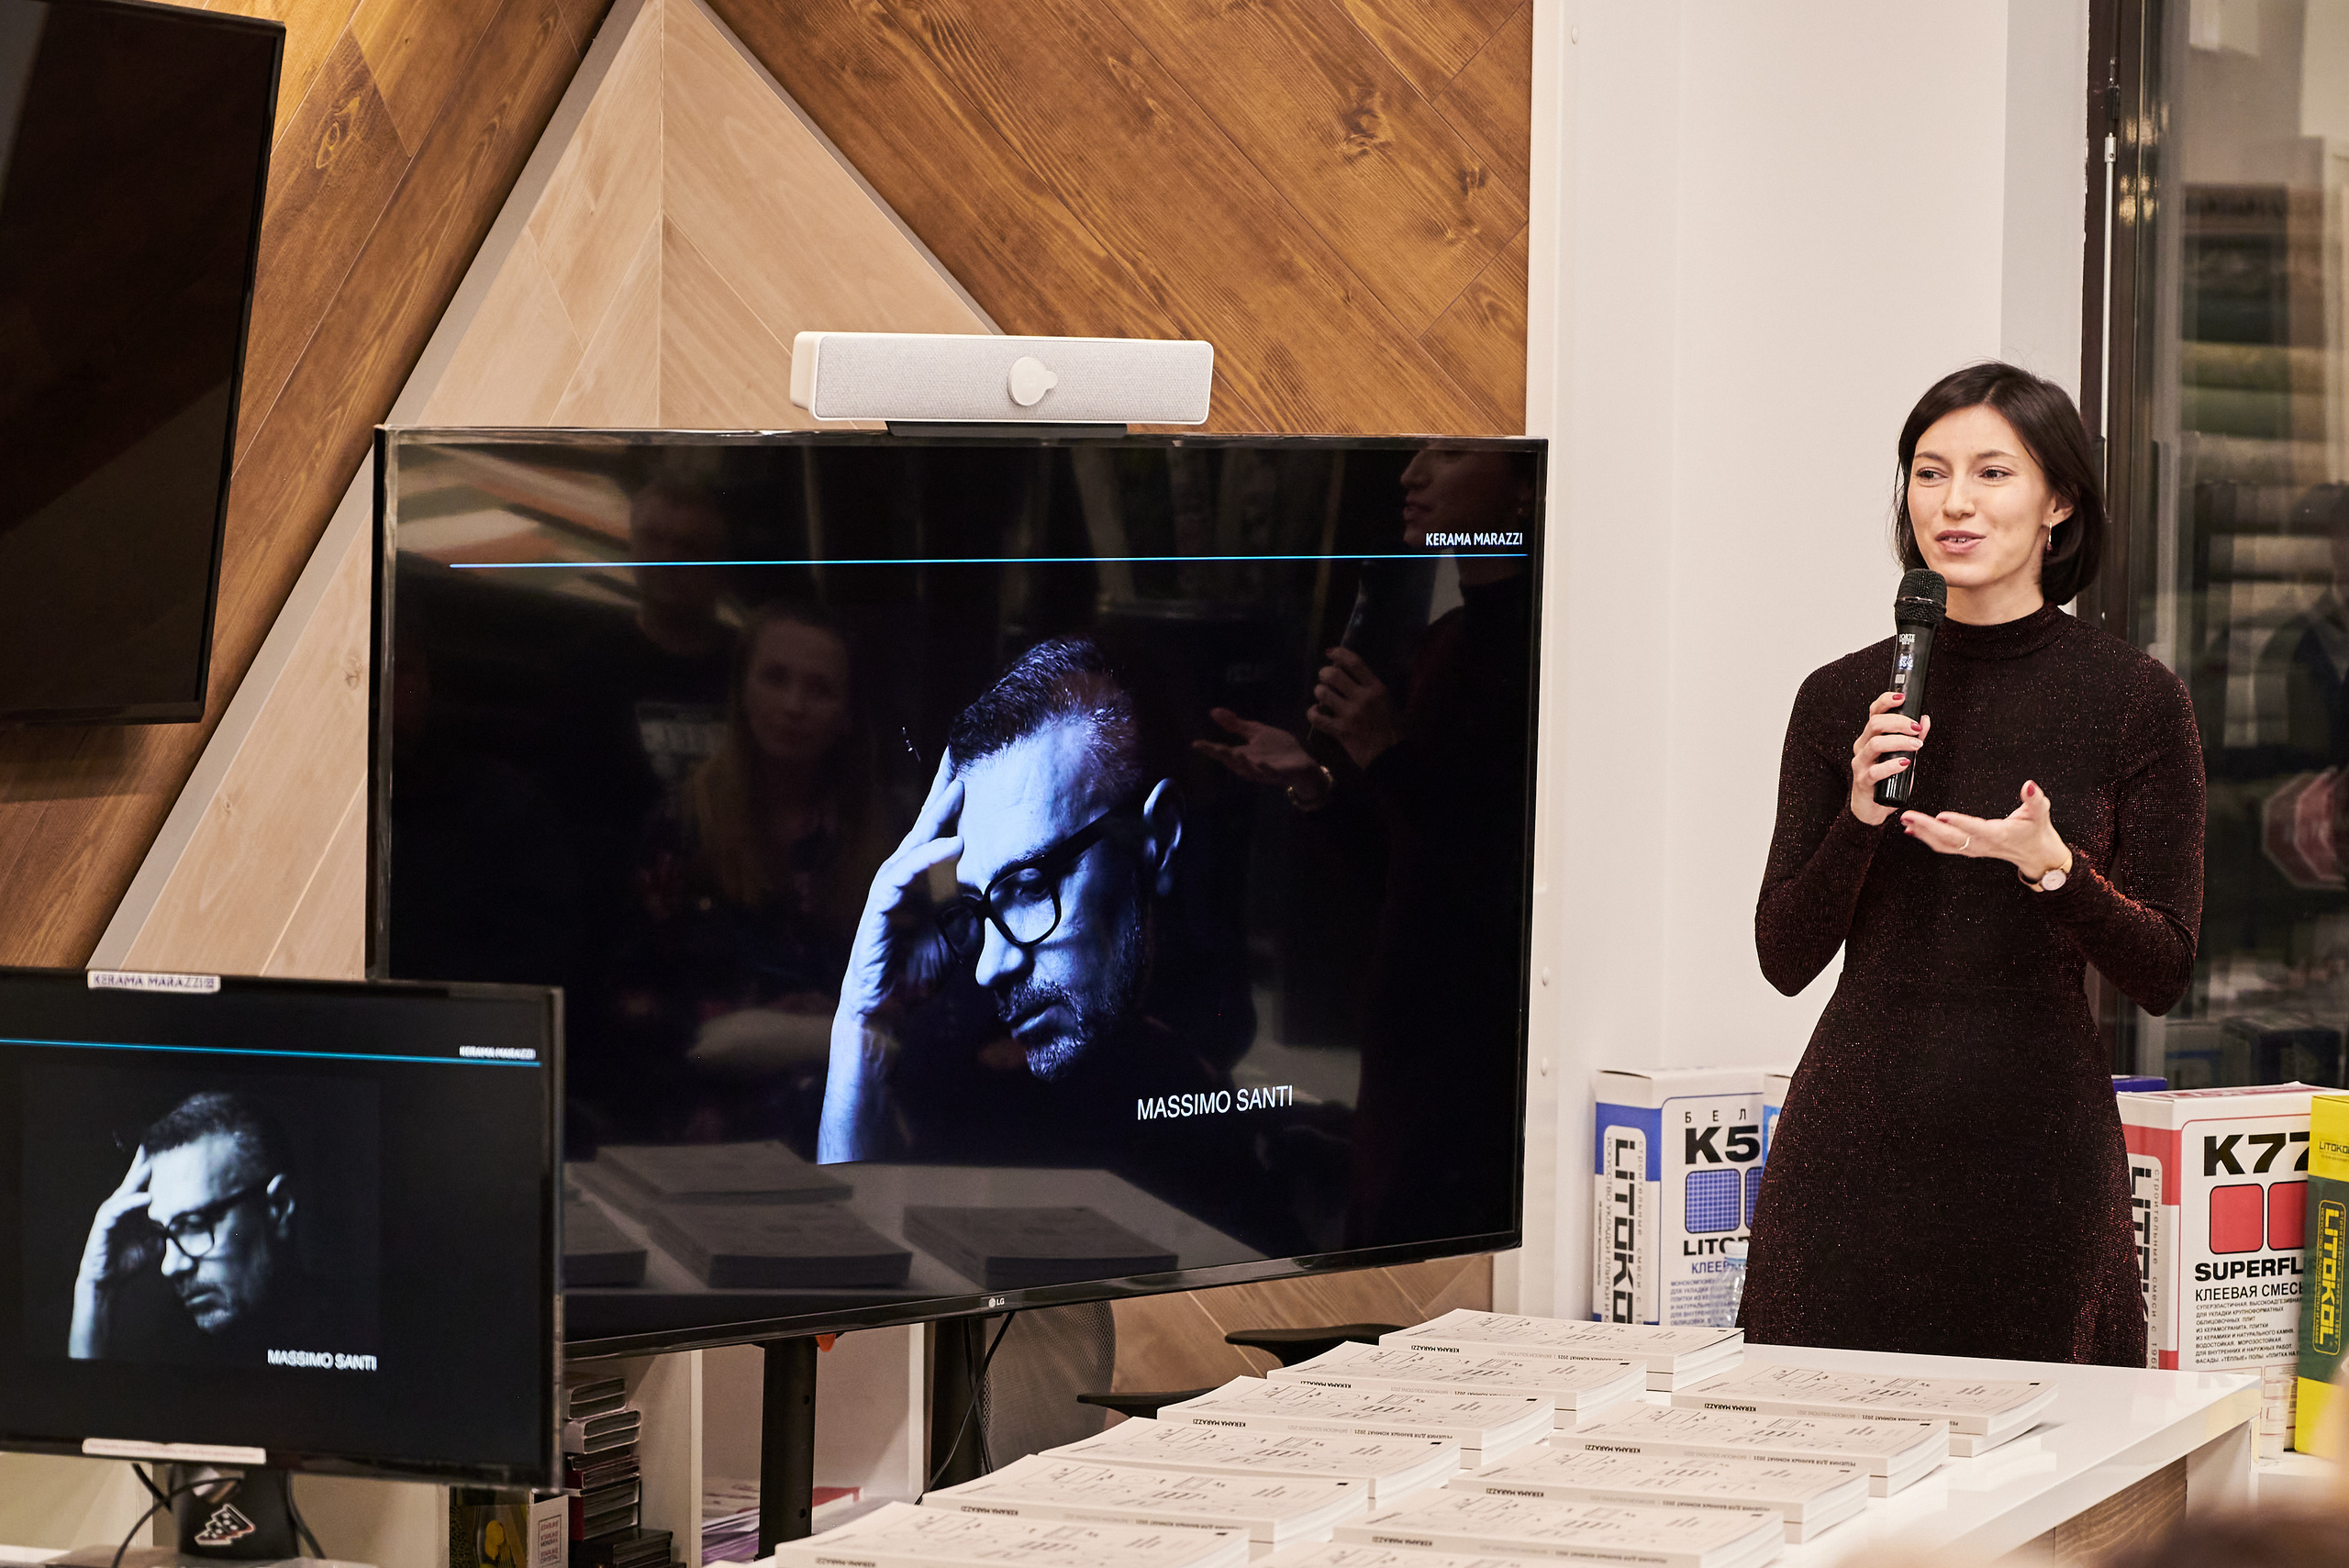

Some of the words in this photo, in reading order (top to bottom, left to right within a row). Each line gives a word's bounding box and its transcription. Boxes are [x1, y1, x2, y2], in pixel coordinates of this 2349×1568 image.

[1425, 532, 1472, 546] KERAMA
[1473, 532, 1523, 546] MARAZZI
[94, 973, 143, 985] KERAMA
[148, 976, 203, 988] MARAZZI
[1137, 1090, 1231, 1120] MASSIMO
[1236, 1084, 1293, 1112] SANTI
[1685, 1108, 1746, 1123] БЕЛ
[1685, 1125, 1761, 1164] K5
[1605, 1137, 1613, 1202] ИСКУССТВО
[1612, 1139, 1635, 1324] LITOKO
[2194, 1256, 2303, 1282] SUPERFL
[2320, 1208, 2339, 1345] LITOKOL
[2195, 1284, 2258, 1302] КЛЕЕВАЯ
[2208, 1309, 2232, 1318] УКЛАДКИ
[2232, 1307, 2284, 1315] КРУПНОФОРМАТНЫХ
[2196, 1318, 2241, 1326] ОБЛИЦОВОЧНЫХ
[2236, 1329, 2276, 1338] НАТУРАЛЬНОГО
[2207, 1348, 2241, 1356] ВНУТРЕННИХ
[2246, 1344, 2275, 1352] НАРУЖНЫХ
[267, 1349, 334, 1369] MASSIMO
[334, 1352, 377, 1372] SANTI
[1704, 1403, 1731, 1411] MARAZZI
[1193, 1418, 1220, 1427] MARAZZI
[1585, 1444, 1613, 1452] MARAZZI
[1486, 1487, 1516, 1496] MARAZZI
[961, 1506, 990, 1515] MARAZZI
